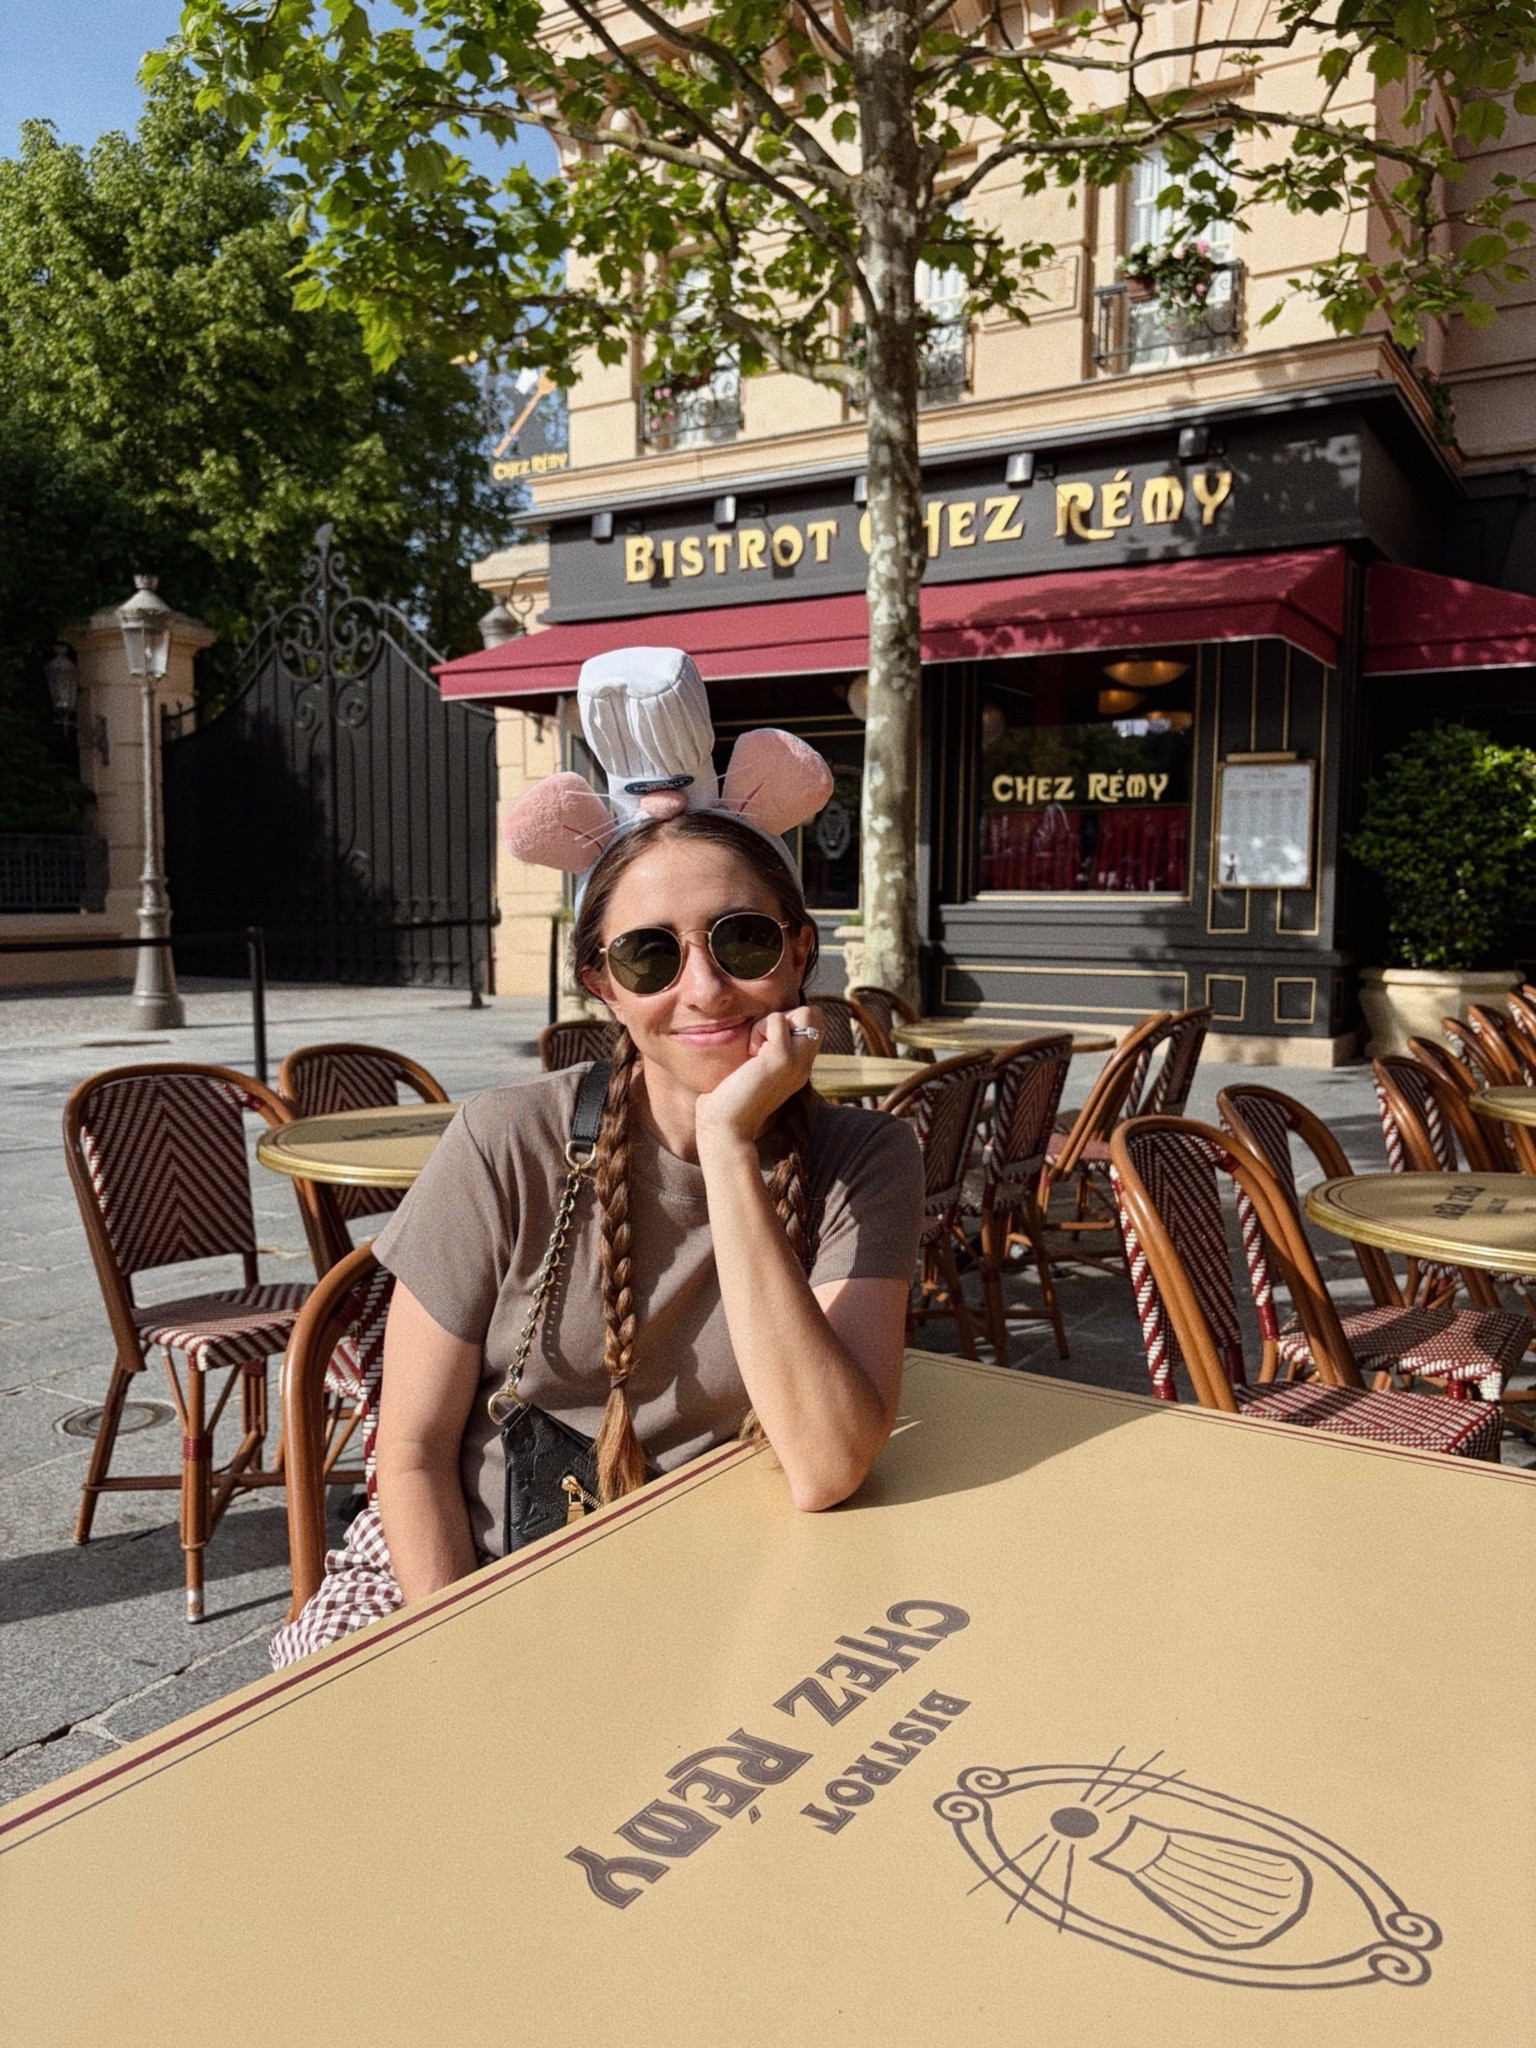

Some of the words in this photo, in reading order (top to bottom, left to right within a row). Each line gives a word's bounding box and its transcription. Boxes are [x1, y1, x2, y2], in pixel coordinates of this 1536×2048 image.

[625, 520, 838, 584] BISTROT
[859, 495, 1025, 558] HEZ
[1055, 469, 1232, 540] RÉMY
[992, 774, 1075, 805] CHEZ
[1088, 768, 1168, 803] RÉMY
[773, 1599, 971, 1726] CHEZ
[565, 1727, 814, 1909] RÉMY
[800, 1689, 972, 1835] BISTROT
